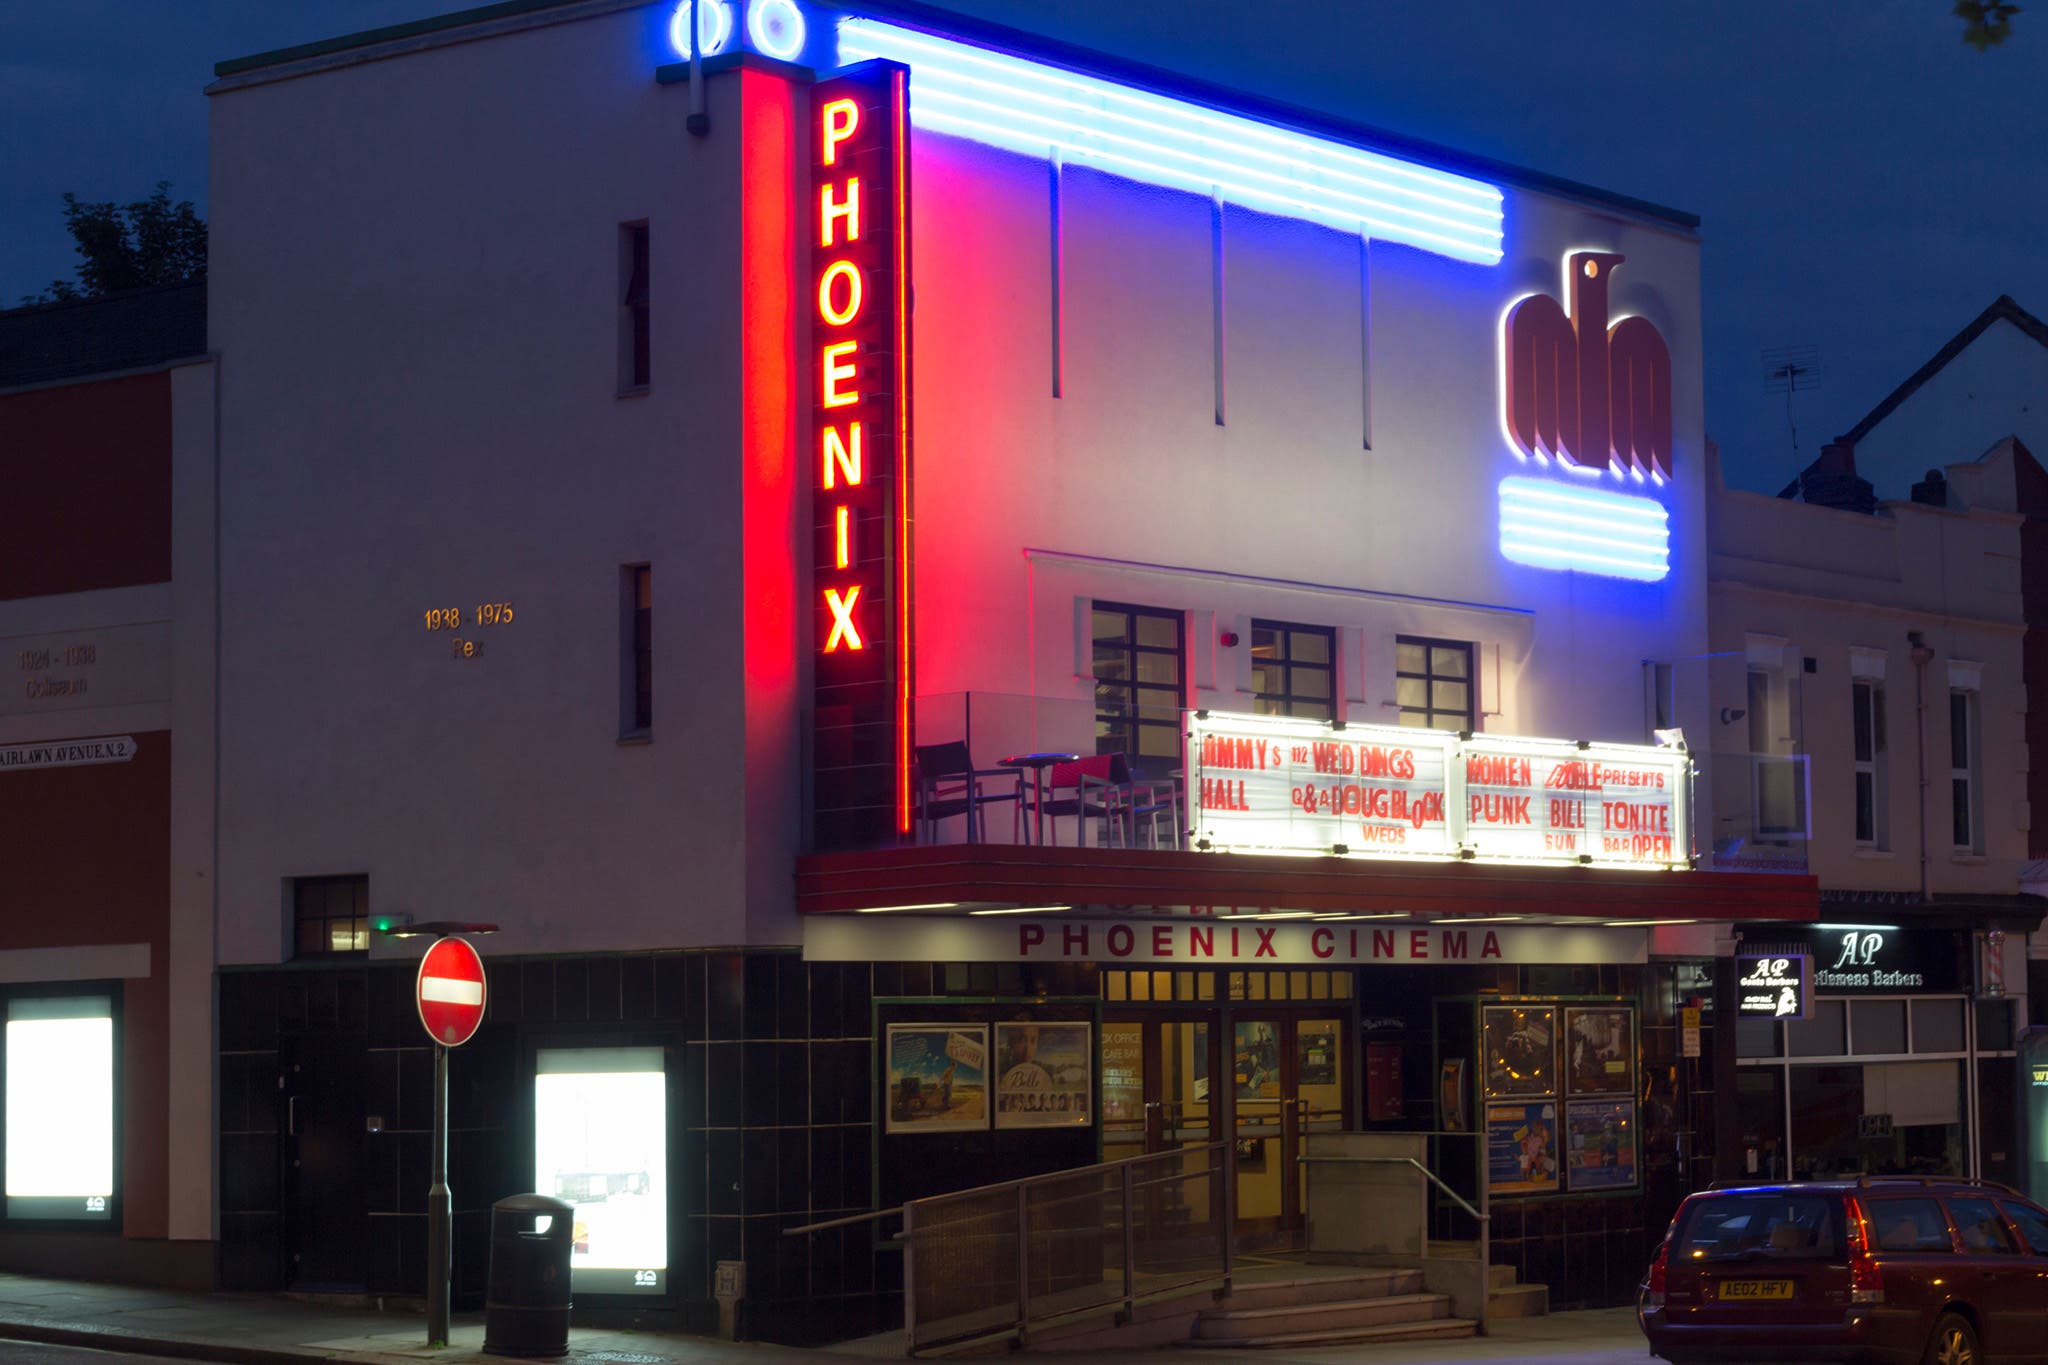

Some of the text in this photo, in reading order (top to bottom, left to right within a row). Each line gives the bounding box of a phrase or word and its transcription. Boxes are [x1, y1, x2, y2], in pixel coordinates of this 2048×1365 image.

[819, 97, 864, 654] PHOENIX
[424, 607, 460, 631] 1938
[476, 602, 513, 626] 1975
[452, 636, 485, 659] Rex
[25, 677, 88, 699] Coliseum
[1291, 745, 1308, 765] 112
[1467, 755, 1532, 786] WOMEN
[1603, 768, 1665, 788] PRESENTS
[1201, 778, 1250, 811] HALL
[1331, 783, 1389, 818] DOUG
[1391, 789, 1446, 829] BLOCK
[1470, 793, 1669, 832] PUNK BILL TONITE
[1362, 823, 1406, 845] WEDS
[1544, 833, 1673, 861] SUN BAR OPEN
[1019, 923, 1503, 960] PHOENIX CINEMA
[1833, 931, 1884, 968] AP
[1750, 958, 1790, 979] AP
[1872, 969, 1923, 986] Barbers
[1724, 1281, 1788, 1297] AE02 HFV
